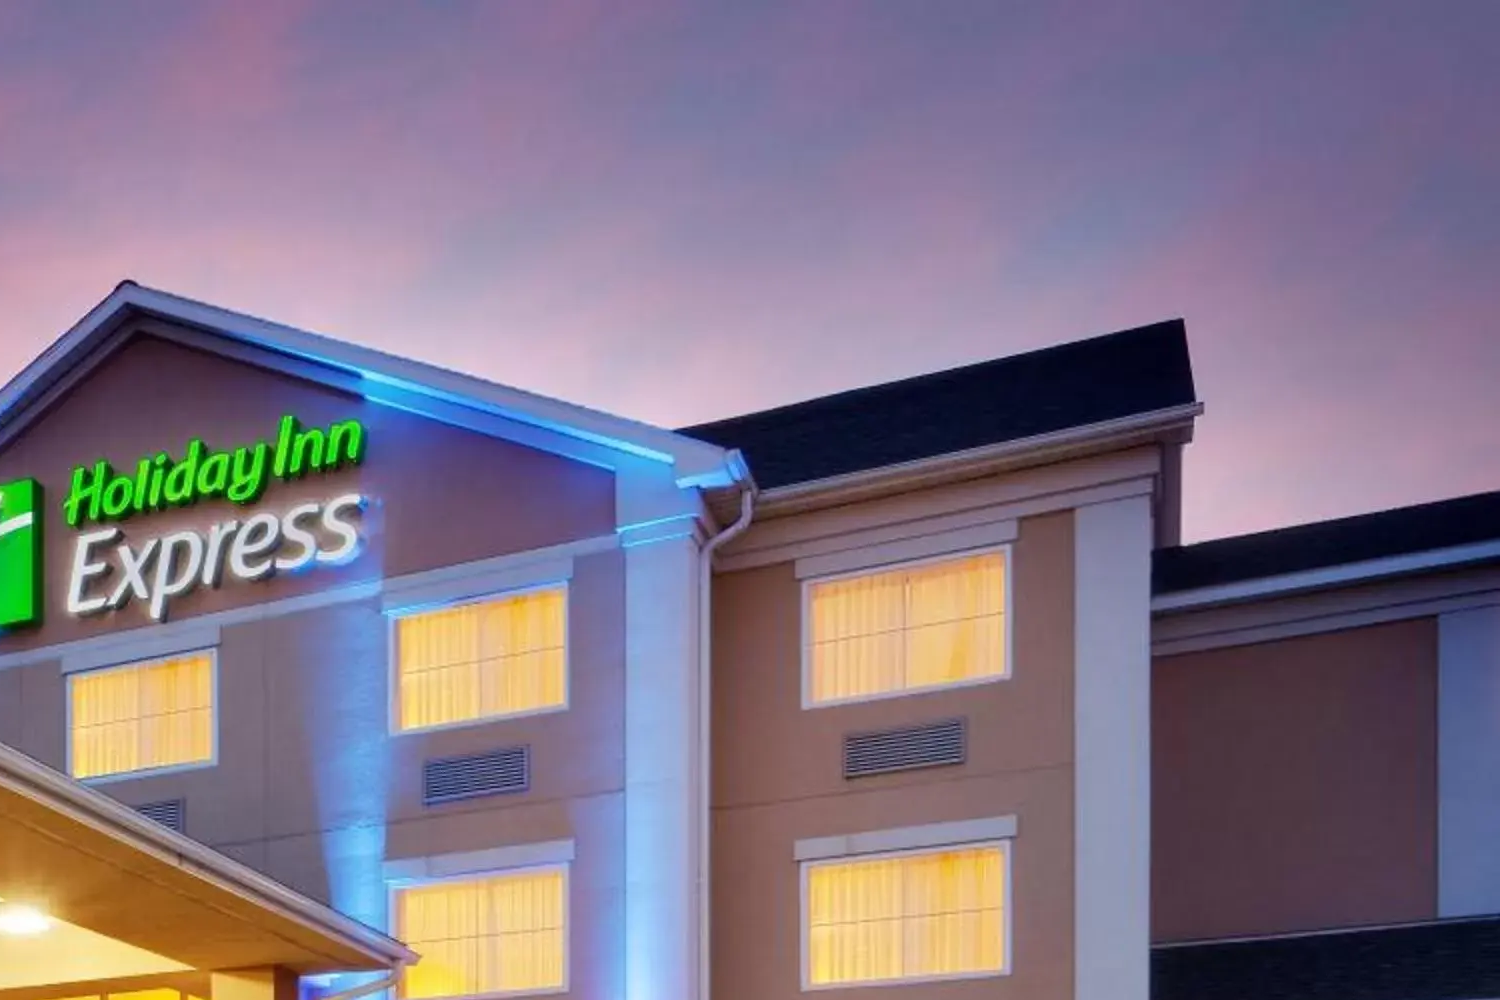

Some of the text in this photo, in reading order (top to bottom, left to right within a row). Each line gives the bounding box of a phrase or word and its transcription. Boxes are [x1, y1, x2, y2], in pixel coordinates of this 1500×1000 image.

[65, 415, 365, 524] Holiday Inn
[66, 493, 363, 620] Express
